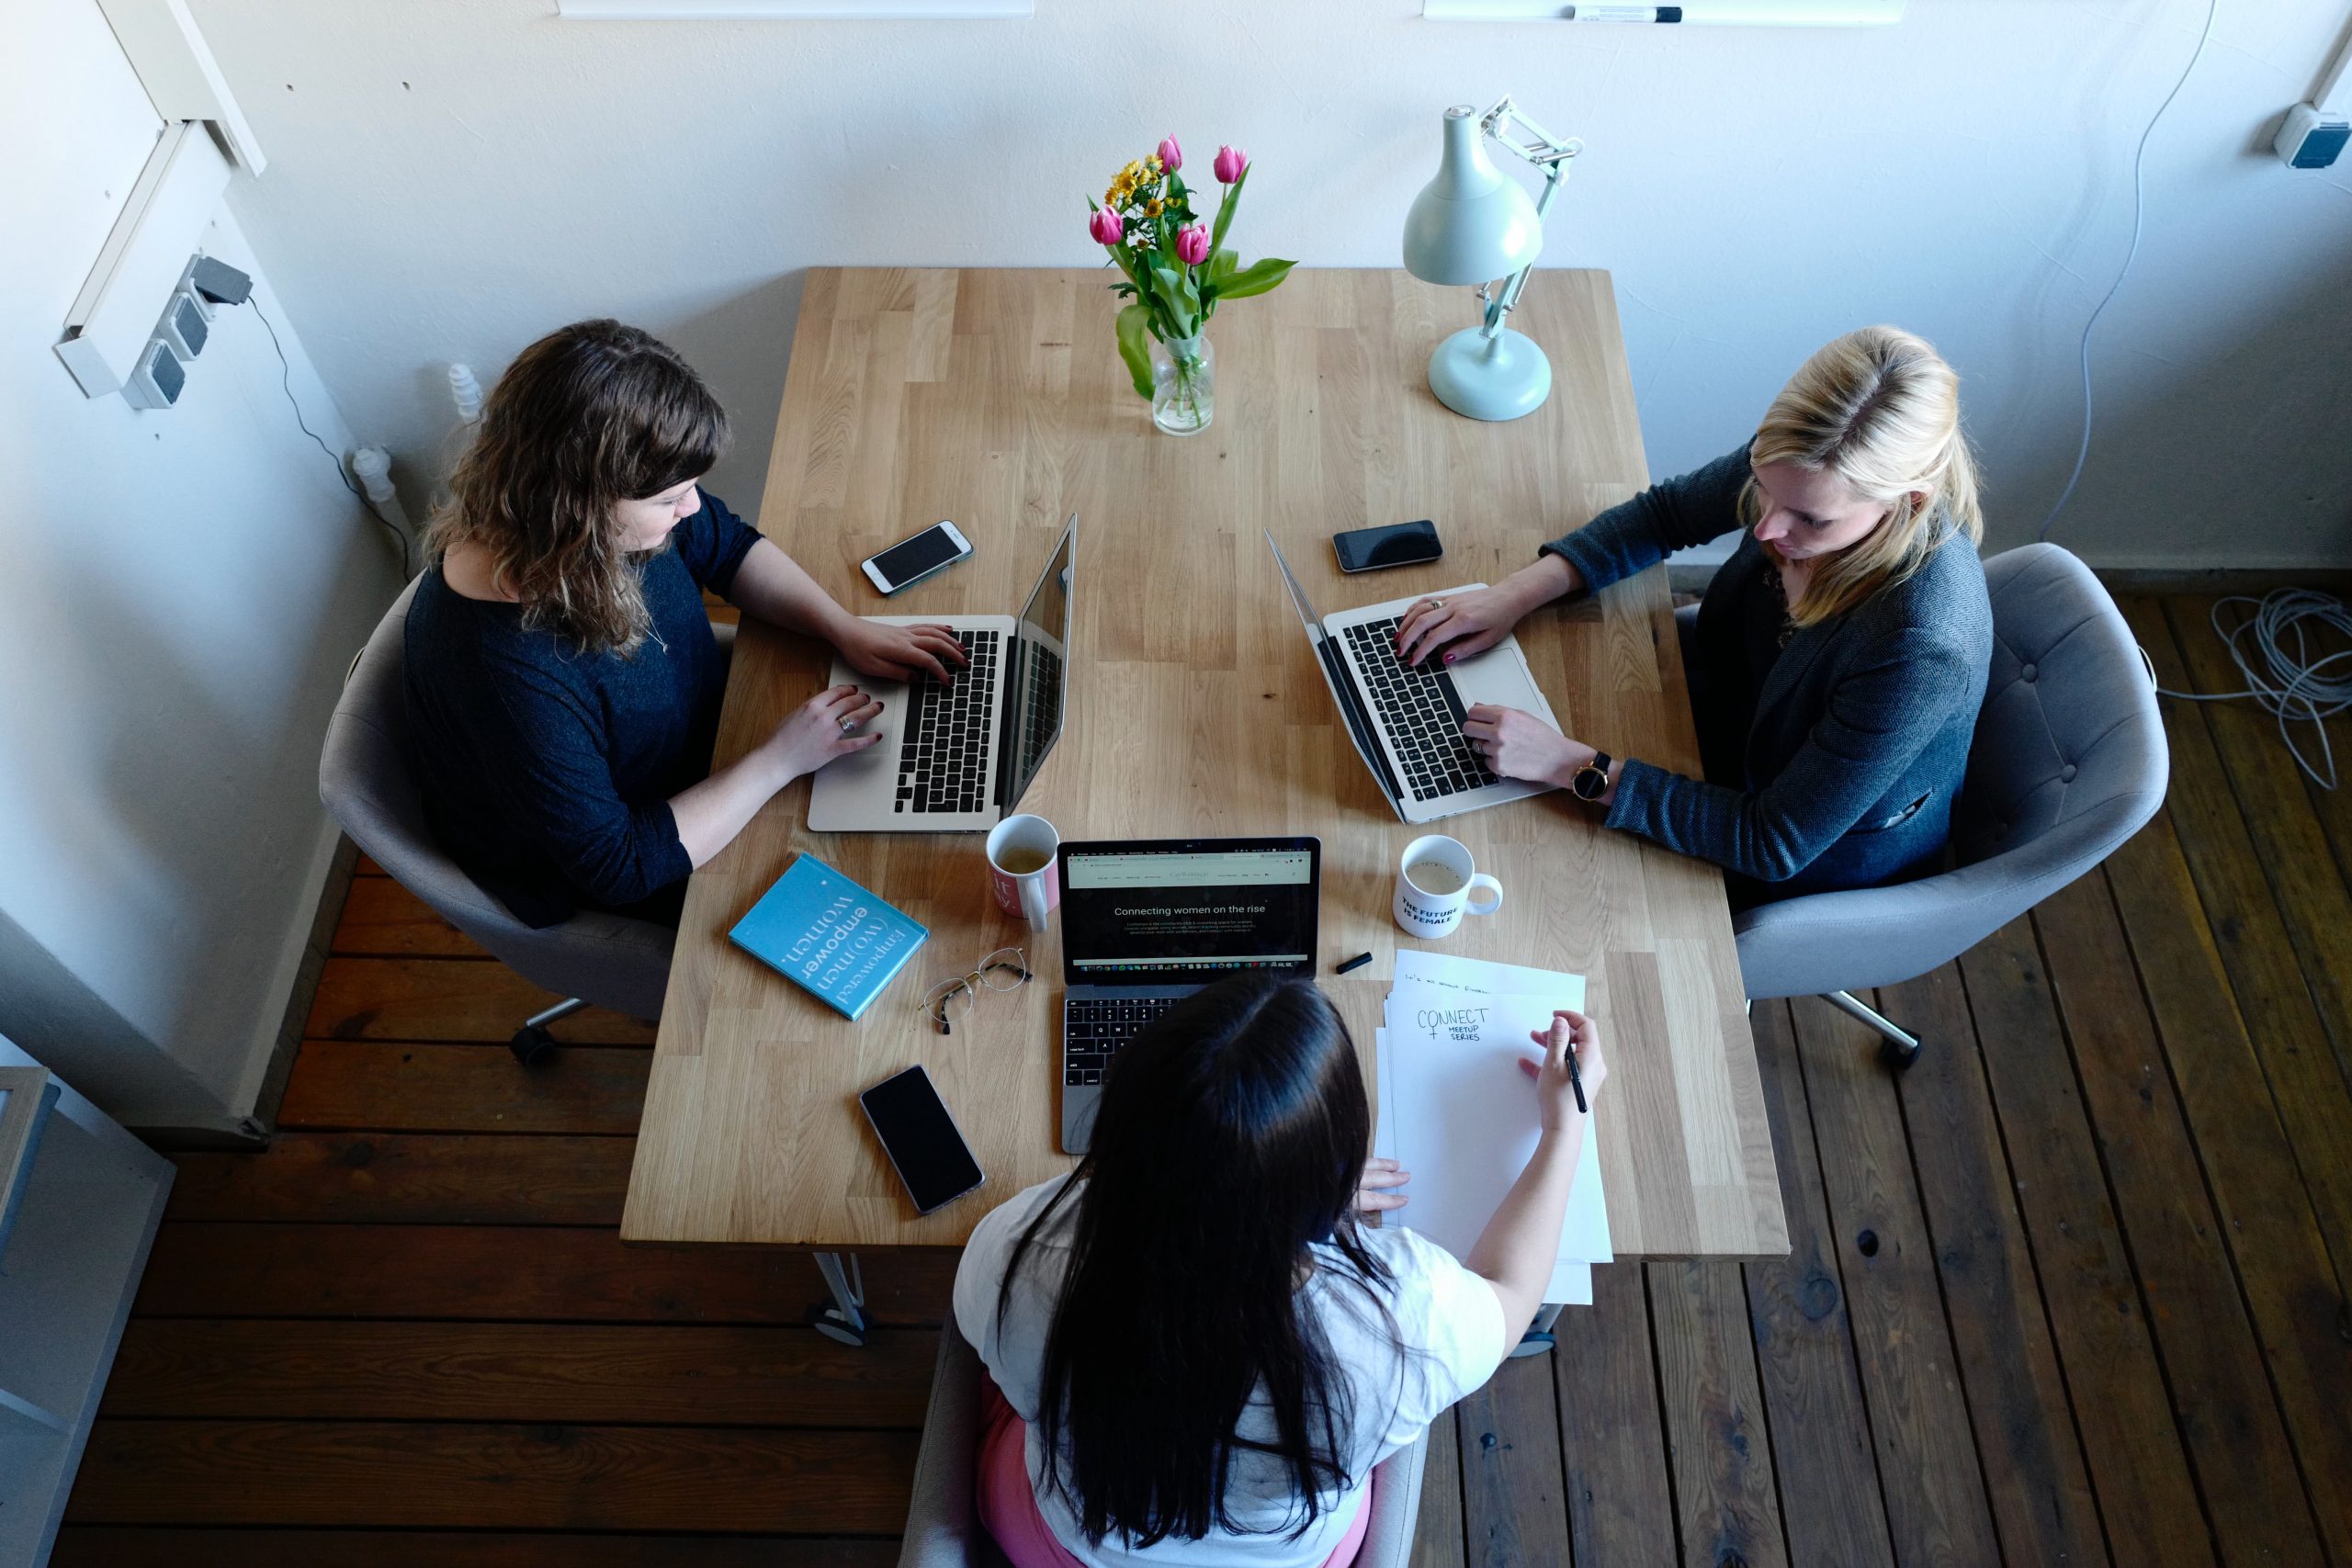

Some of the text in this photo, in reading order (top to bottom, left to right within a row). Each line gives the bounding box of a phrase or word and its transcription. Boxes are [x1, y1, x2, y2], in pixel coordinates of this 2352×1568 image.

[1114, 908, 1171, 917] Connecting
[1173, 906, 1211, 914] women
[1247, 905, 1266, 913] rise
[1403, 896, 1419, 912] THE
[1404, 908, 1452, 925] IS FEMALE
[781, 897, 853, 962] women.
[801, 907, 867, 979] empower
[836, 929, 906, 1004] Empowered
[1418, 1008, 1489, 1039] CONNECT
[1448, 1024, 1479, 1033] MEETUP
[1451, 1033, 1480, 1042] SERIES
